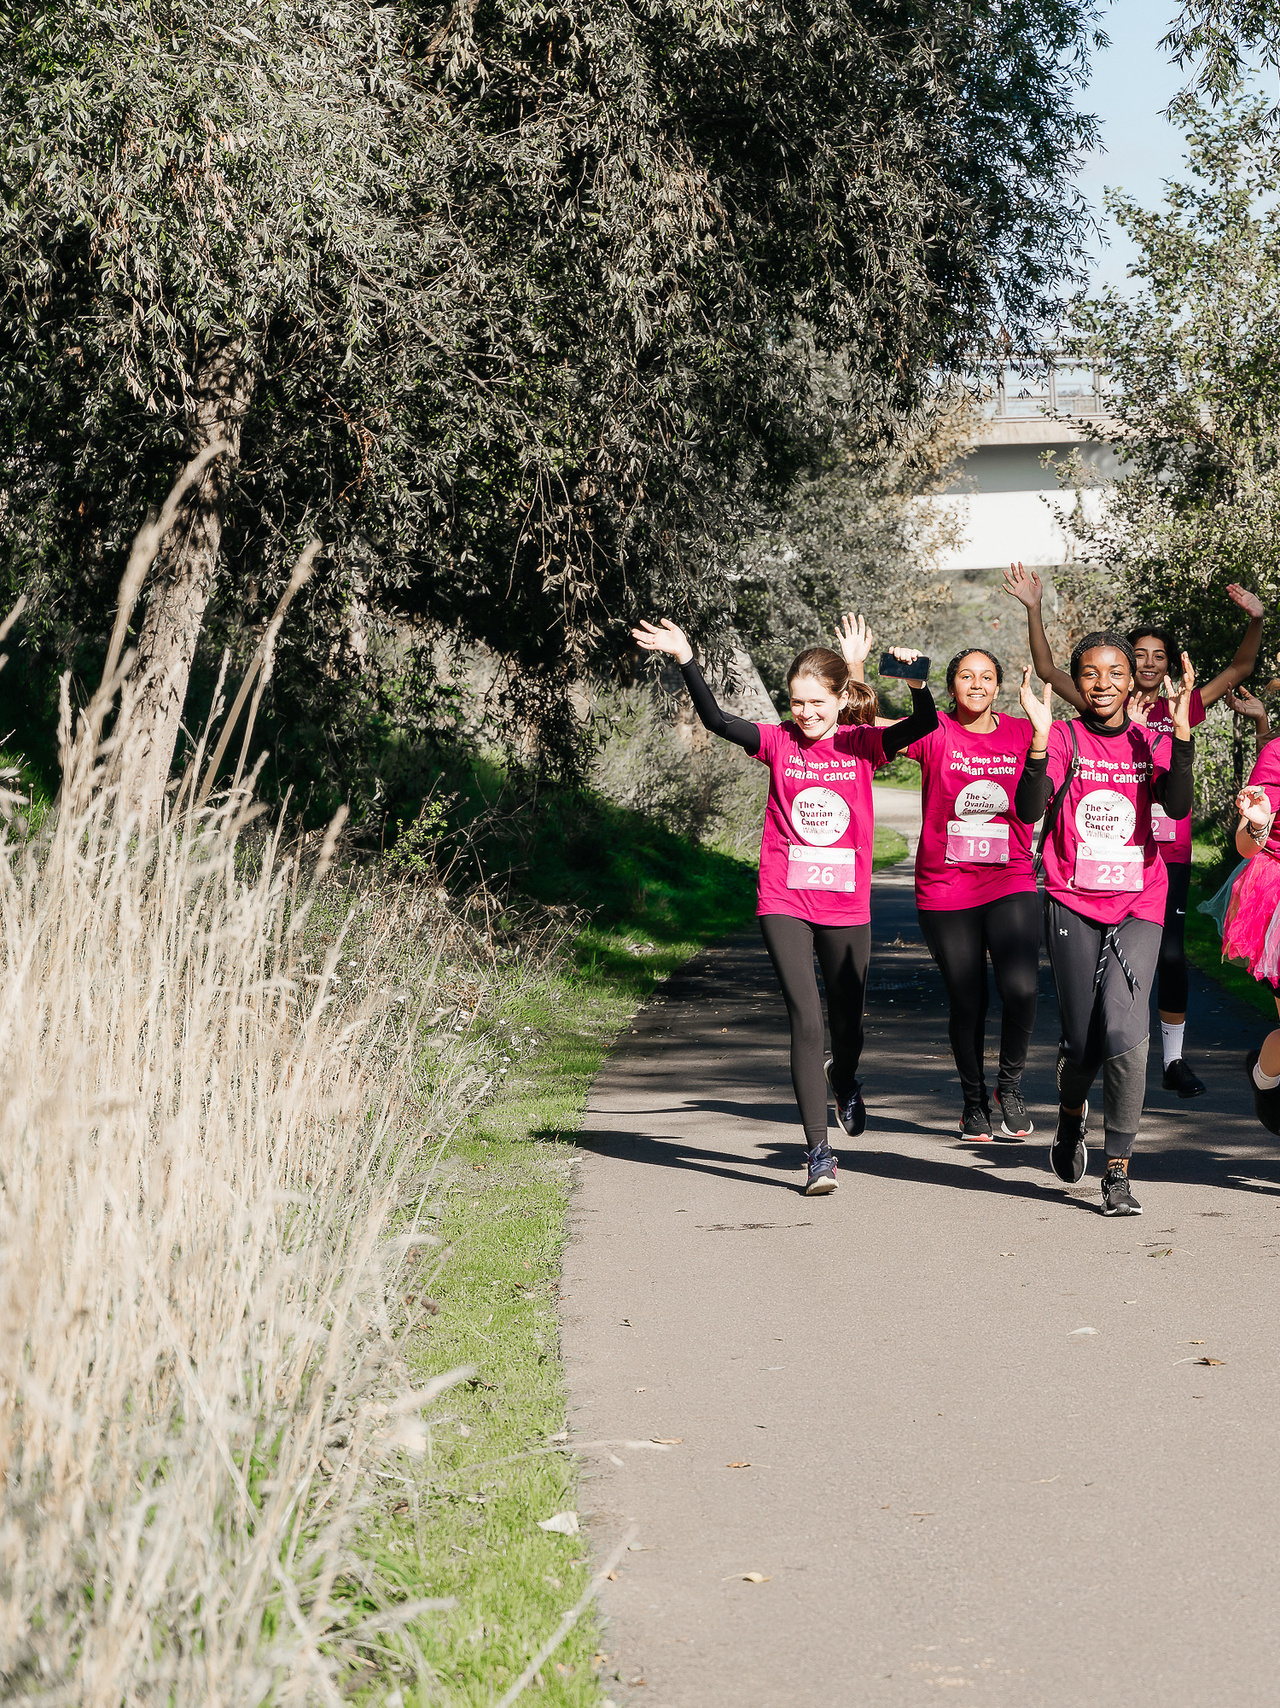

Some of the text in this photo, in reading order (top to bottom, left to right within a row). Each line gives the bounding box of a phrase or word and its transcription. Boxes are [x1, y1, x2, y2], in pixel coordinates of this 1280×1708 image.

[831, 760, 840, 768] to
[842, 759, 857, 768] bea
[952, 751, 970, 765] Tag
[971, 756, 991, 765] steps
[1078, 756, 1096, 769] king
[1097, 760, 1119, 770] steps
[1121, 762, 1130, 770] to
[785, 768, 856, 782] ovaran cance
[950, 763, 1016, 776] ovarian cancer
[1074, 768, 1146, 783] oarian cancer
[799, 801, 815, 809] The
[965, 801, 994, 809] Ovarian
[1085, 804, 1101, 812] The
[800, 810, 833, 818] Ovarian
[1085, 813, 1119, 822] Ovarian
[801, 818, 829, 827] Cancer
[1085, 821, 1114, 831] Cancer
[967, 840, 990, 857] 19
[807, 866, 834, 885] 26
[1097, 865, 1126, 885] 23
